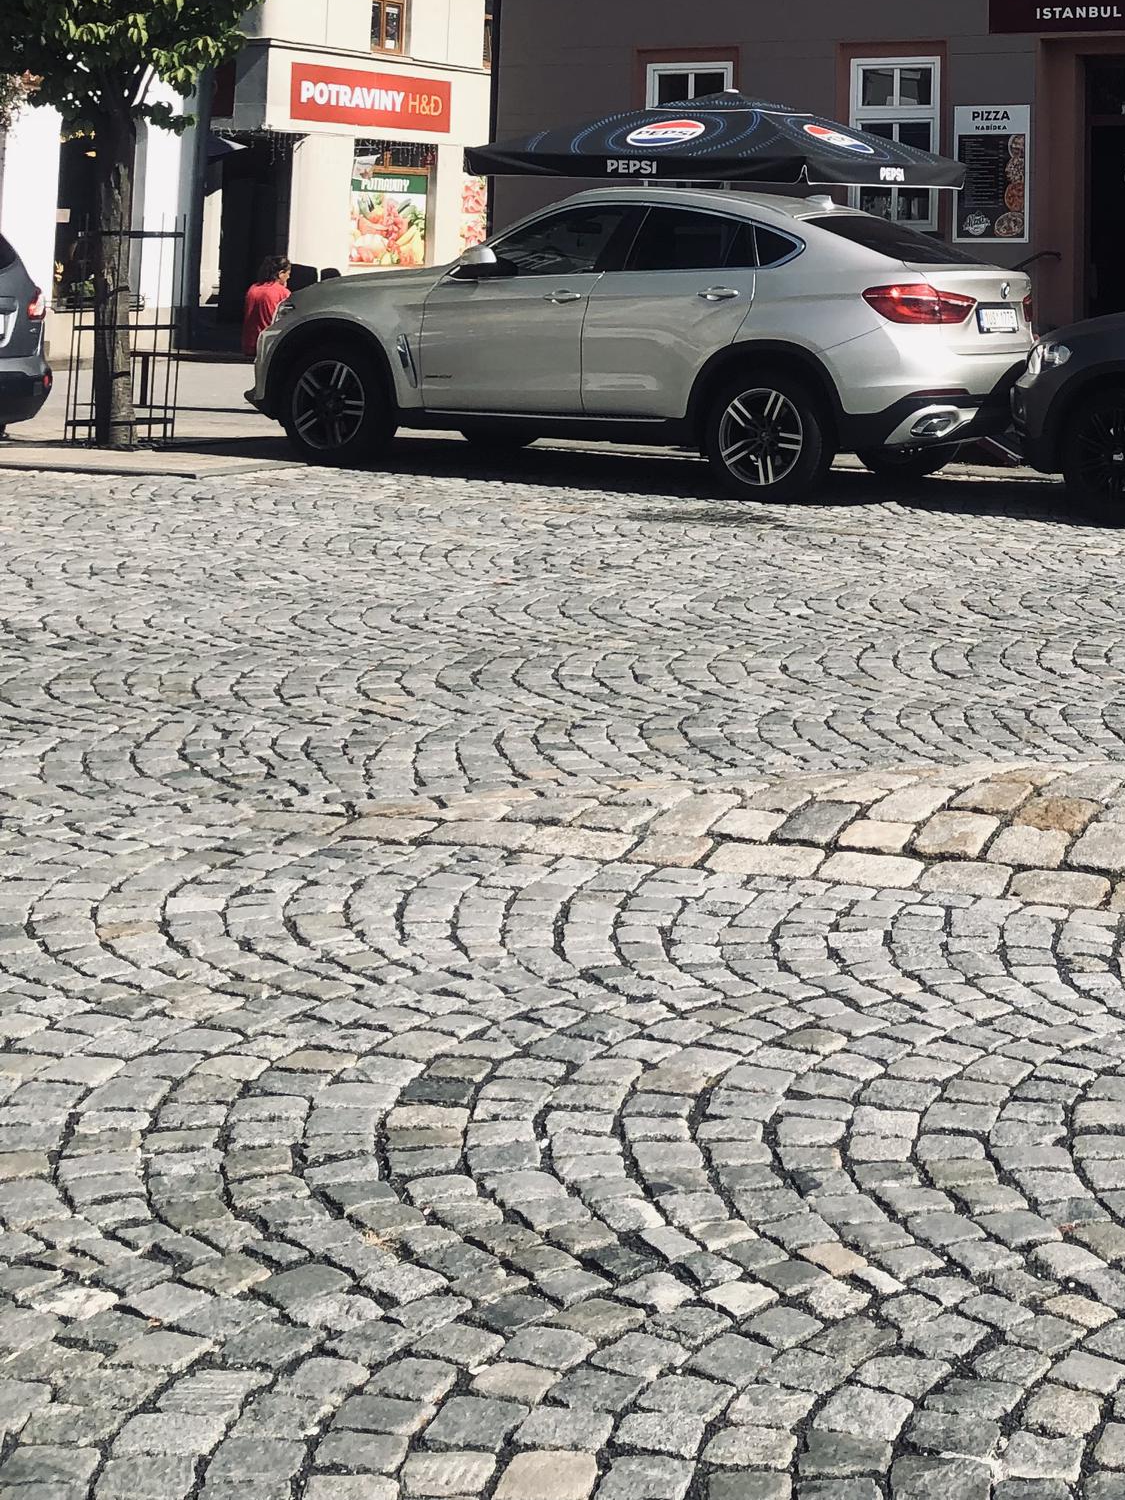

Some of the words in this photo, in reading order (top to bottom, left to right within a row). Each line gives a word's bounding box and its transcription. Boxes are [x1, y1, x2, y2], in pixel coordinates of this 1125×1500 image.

[1036, 5, 1122, 19] ISTANBUL
[300, 80, 405, 112] POTRAVINY
[408, 93, 442, 116] H&D
[972, 111, 1010, 121] PIZZA
[607, 160, 657, 174] PEPSI
[880, 167, 905, 181] PEPSI
